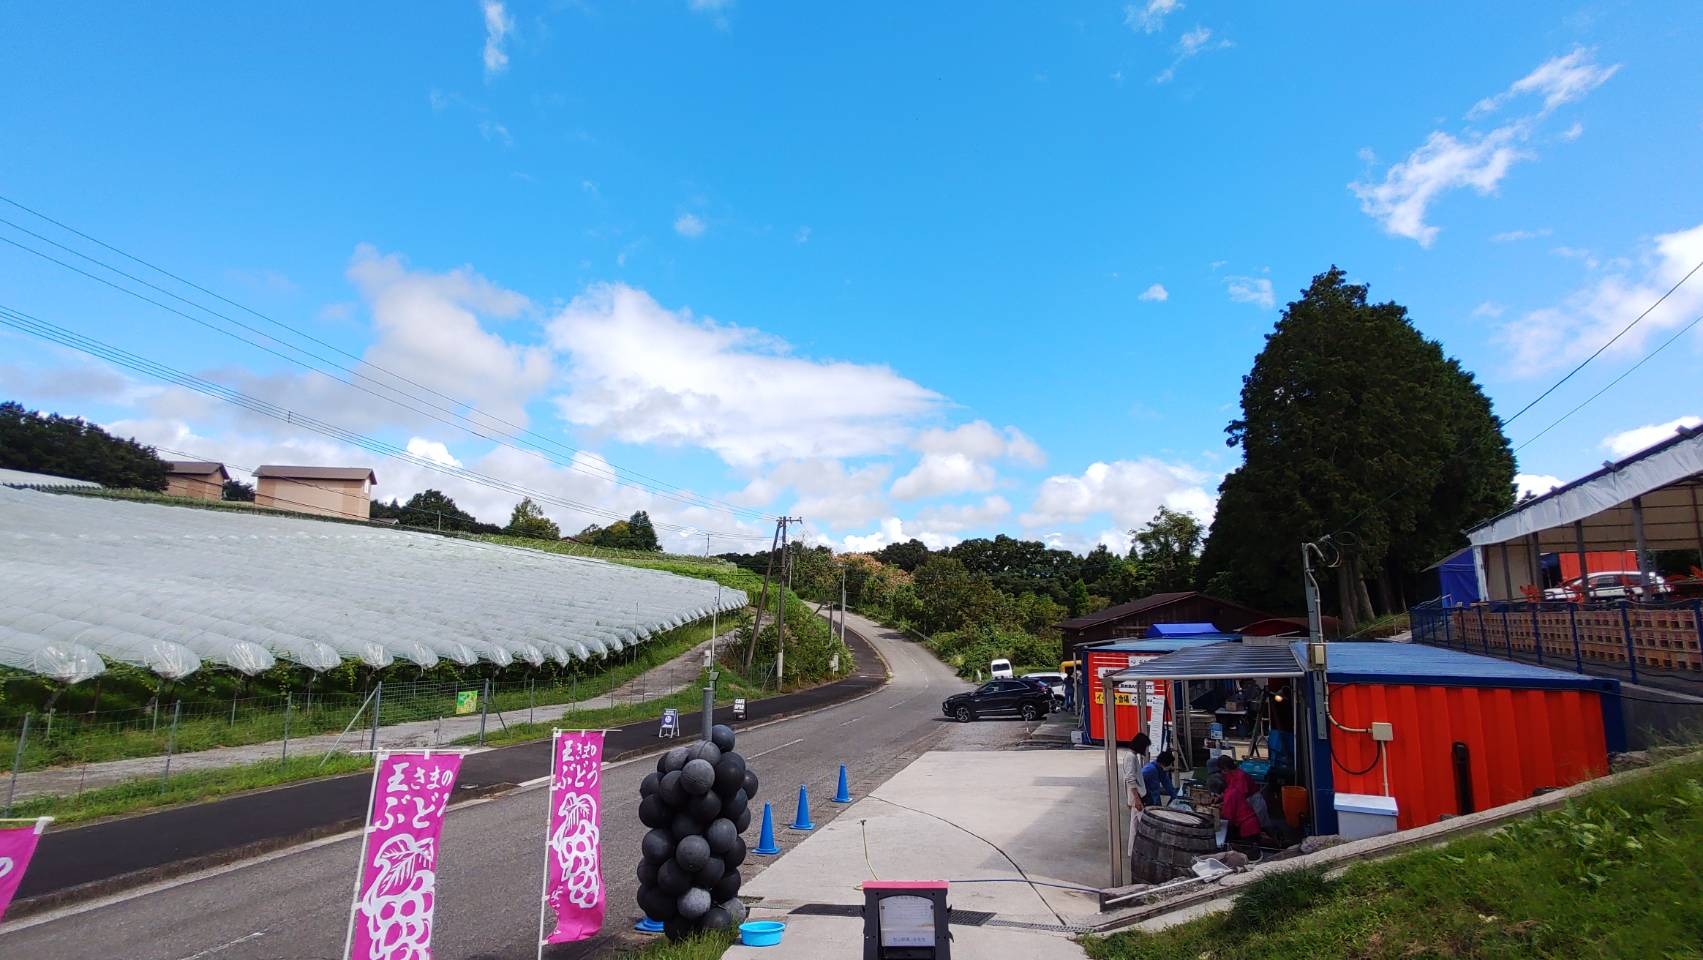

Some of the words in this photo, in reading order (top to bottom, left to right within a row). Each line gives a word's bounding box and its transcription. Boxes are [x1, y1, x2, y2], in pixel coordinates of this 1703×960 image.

[562, 740, 597, 761] 王さまの
[387, 762, 453, 792] 王さまの
[557, 760, 598, 789] ぶどう
